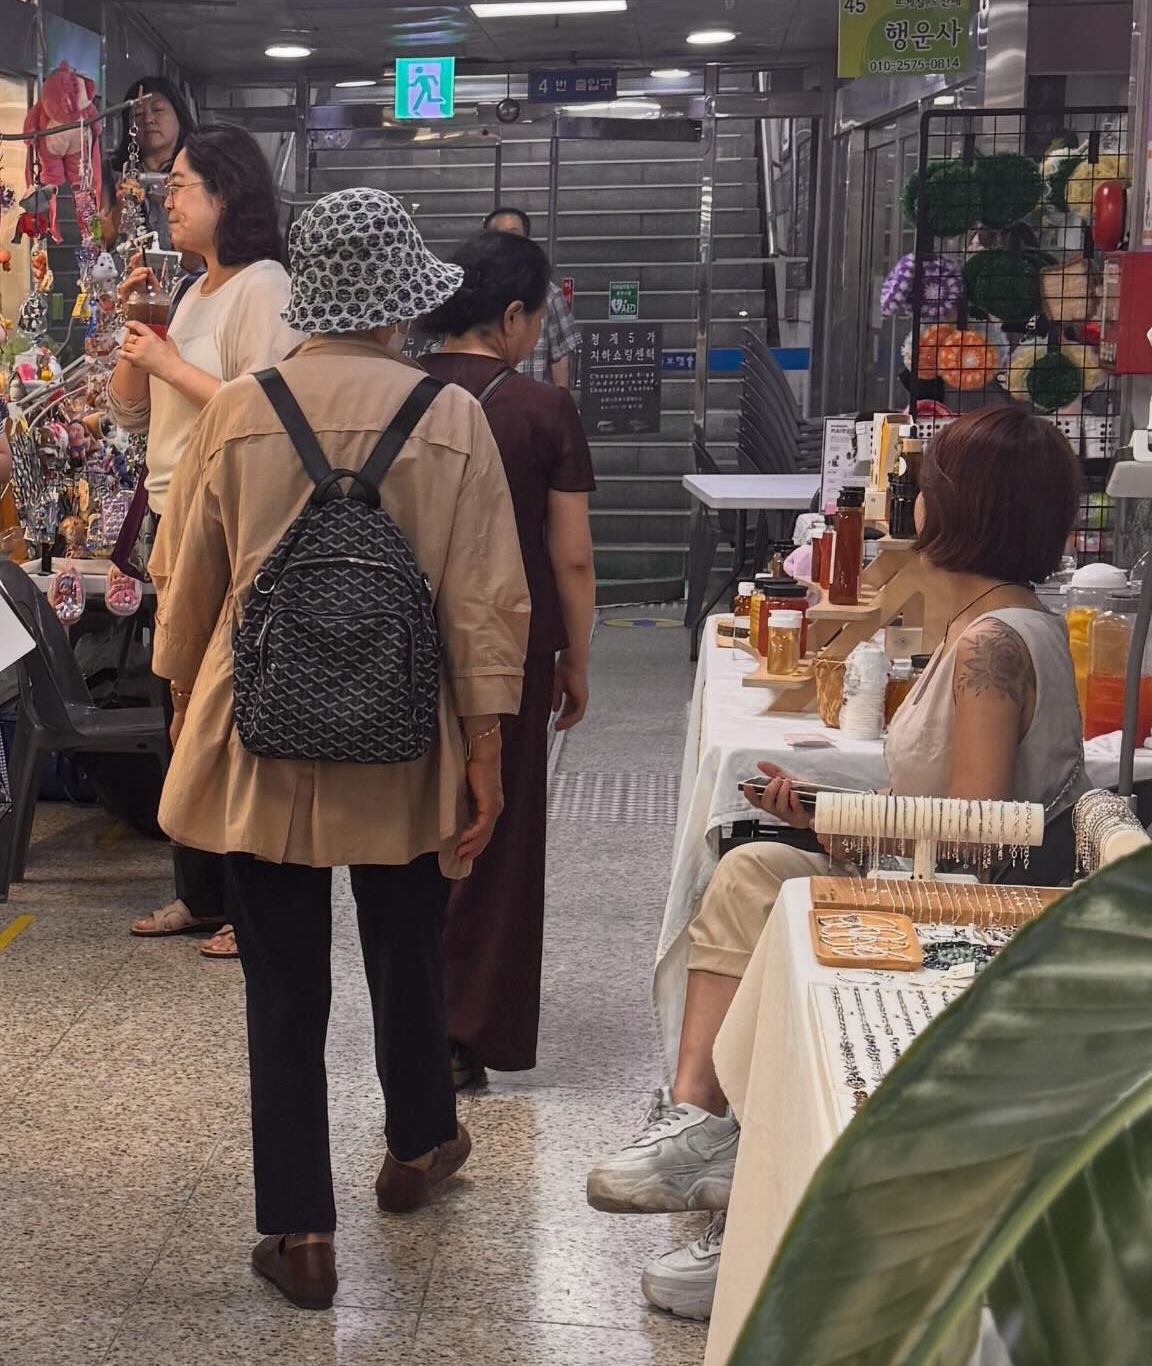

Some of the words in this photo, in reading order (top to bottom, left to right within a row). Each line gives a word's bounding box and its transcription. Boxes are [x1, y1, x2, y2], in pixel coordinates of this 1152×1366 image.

[885, 18, 962, 51] 행운사
[869, 58, 960, 72] 010-2575-0814
[538, 79, 548, 93] 4
